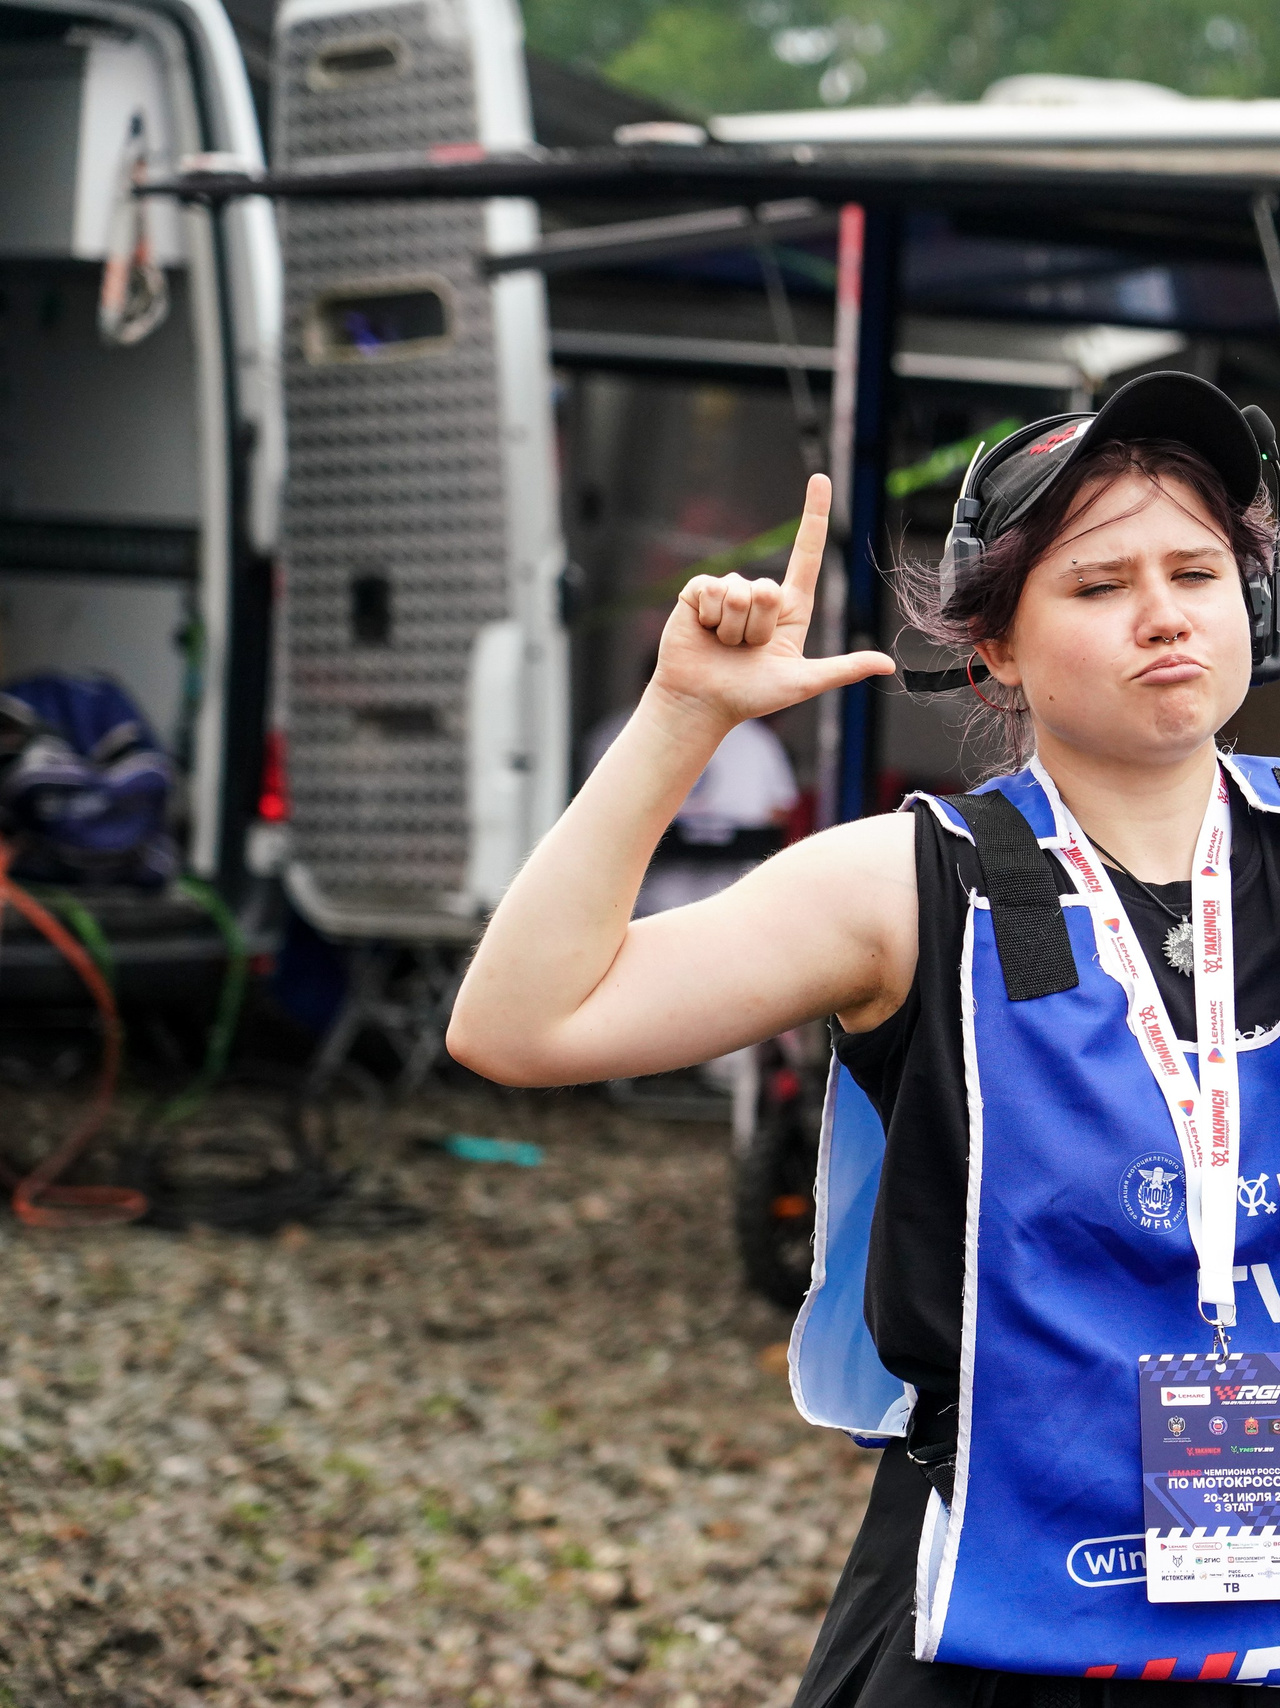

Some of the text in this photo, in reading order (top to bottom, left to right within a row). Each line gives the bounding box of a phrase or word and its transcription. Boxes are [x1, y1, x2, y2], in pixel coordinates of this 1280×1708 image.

[1206, 826, 1220, 864] LEMARC
[1067, 846, 1103, 893] YAKHNICH
[1203, 900, 1217, 956] YAKHNICH
[1116, 936, 1139, 979] LEMARC
[1210, 1000, 1218, 1044] LEMARC
[1143, 1026, 1156, 1052] motorsport
[1148, 1023, 1180, 1075] YAKHNICH
[1211, 1089, 1225, 1148] YAKHNICH
[1126, 1156, 1179, 1179] МОТОЦИКЛЕТНОГО
[1123, 1181, 1138, 1220] ФЕДЕРАЦИЯ
[1140, 1216, 1172, 1229] MFR
[1168, 1469, 1203, 1477] LEMARC
[1204, 1468, 1257, 1476] ЧЕМПИОНАТ
[1168, 1477, 1189, 1489] ПО
[1203, 1493, 1234, 1503] 20-21
[1237, 1492, 1272, 1502] ИЮЛЯ
[1214, 1503, 1254, 1512] 3 ЭТАП
[1161, 1573, 1195, 1581] ИСТОКСКИЙ
[1223, 1583, 1240, 1593] ТВ
